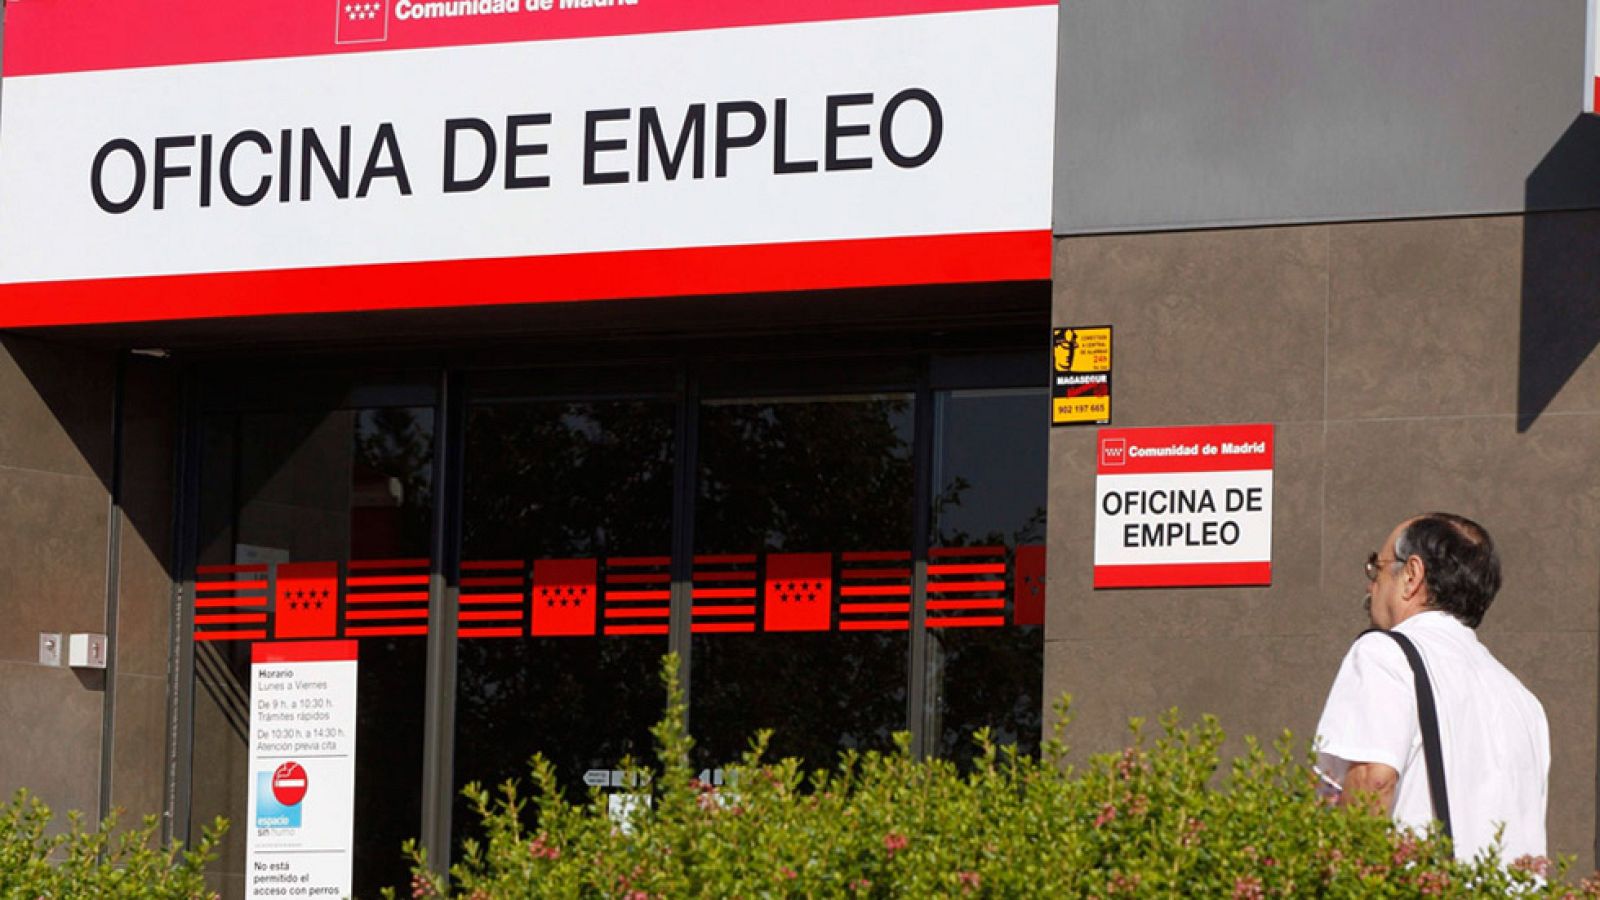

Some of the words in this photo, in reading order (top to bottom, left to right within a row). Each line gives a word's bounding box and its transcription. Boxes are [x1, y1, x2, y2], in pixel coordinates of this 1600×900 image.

[395, 0, 519, 20] Comunidad
[526, 0, 553, 11] de
[91, 123, 412, 214] OFICINA
[444, 113, 551, 193] DE
[583, 88, 942, 185] EMPLEO
[1058, 405, 1072, 414] 902
[1075, 404, 1088, 413] 197
[1128, 443, 1199, 457] Comunidad
[1202, 443, 1217, 455] de
[1221, 441, 1266, 455] Madrid
[1103, 490, 1215, 515] OFICINA
[1226, 488, 1262, 511] DE
[1125, 521, 1239, 547] EMPLEO
[258, 669, 294, 679] Horario
[258, 681, 285, 691] Lunes
[295, 680, 328, 690] Viernes
[258, 699, 269, 709] De
[272, 699, 278, 709] 9
[258, 711, 294, 721] Trámites
[297, 710, 331, 721] rápidos
[257, 729, 269, 739] De
[257, 741, 293, 751] Atención
[294, 742, 319, 752] previa
[321, 740, 337, 750] cita
[257, 816, 289, 827] espacio
[257, 828, 270, 837] sin
[254, 862, 268, 871] No
[269, 861, 290, 871] está
[253, 873, 298, 884] permitido
[300, 873, 309, 882] el
[253, 887, 287, 896] acceso
[289, 886, 307, 895] con
[309, 886, 340, 897] perros
